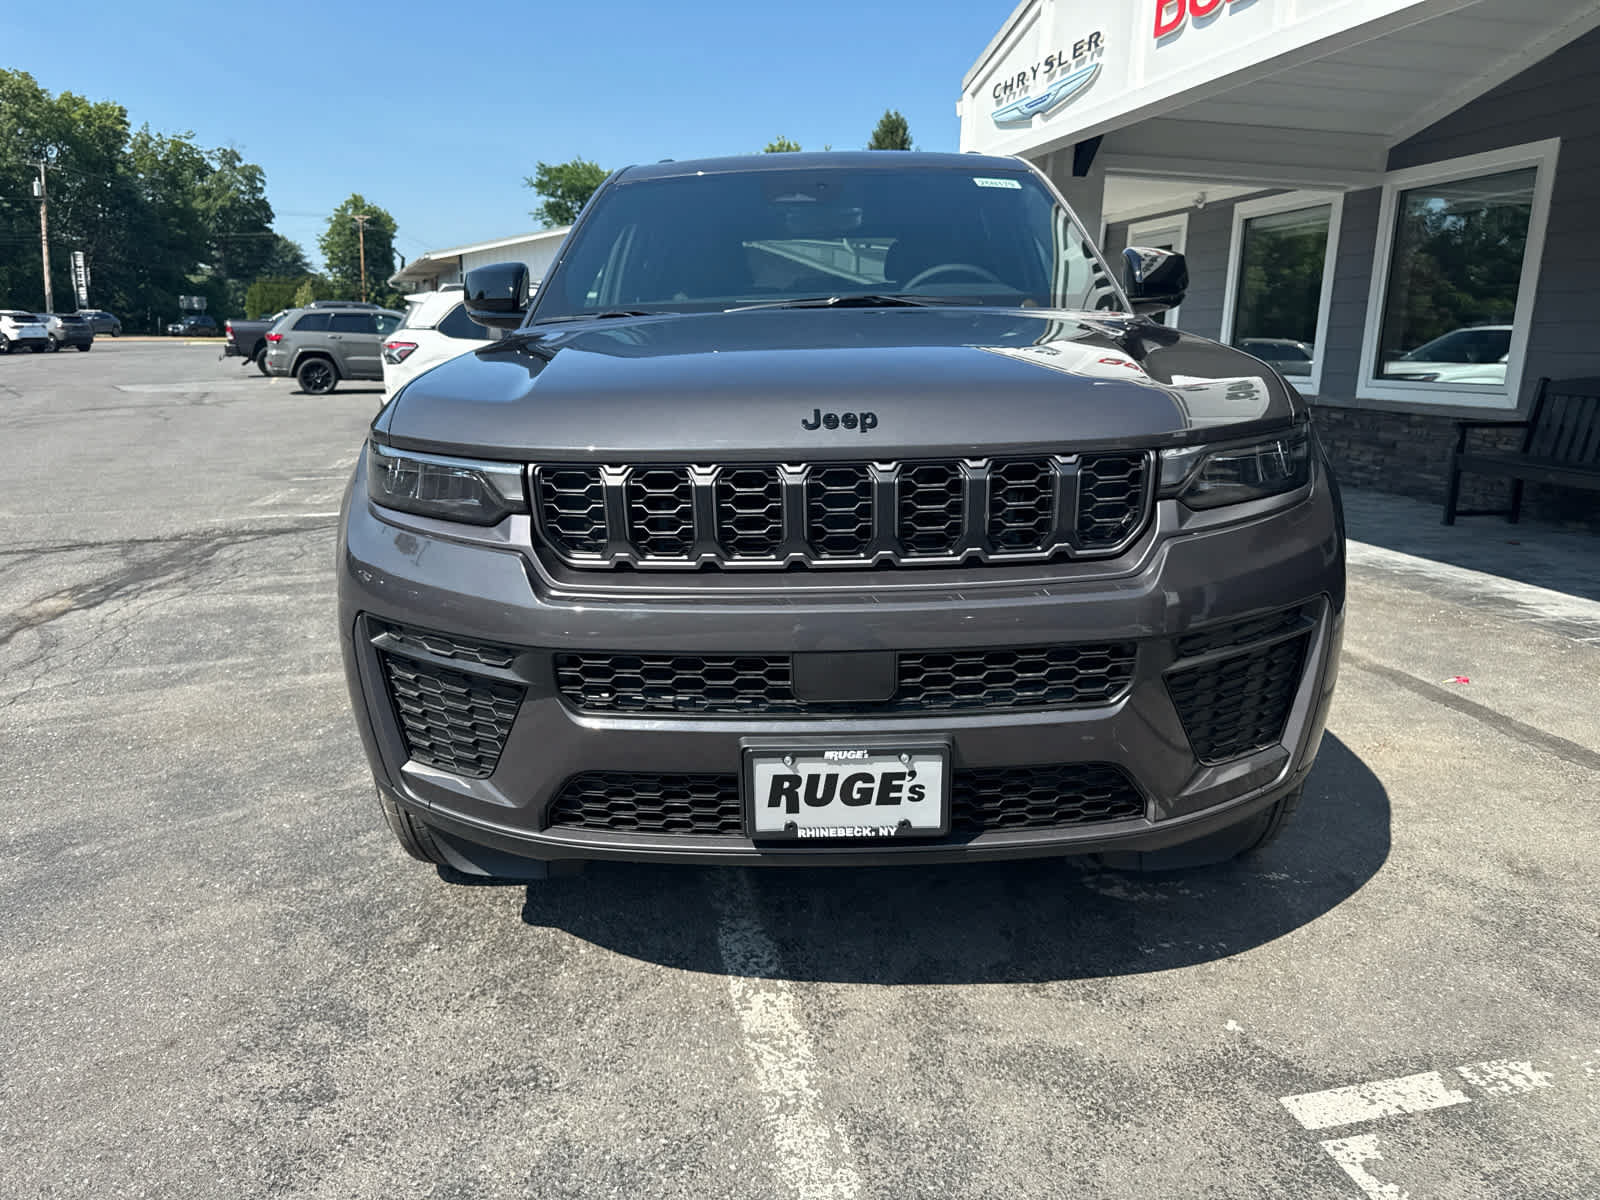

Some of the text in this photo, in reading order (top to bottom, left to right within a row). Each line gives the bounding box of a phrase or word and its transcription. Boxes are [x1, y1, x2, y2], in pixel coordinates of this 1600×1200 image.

[992, 31, 1102, 99] CHRYSLER
[801, 408, 878, 433] Jeep
[767, 770, 926, 814] RUGE's
[879, 826, 897, 837] NY
